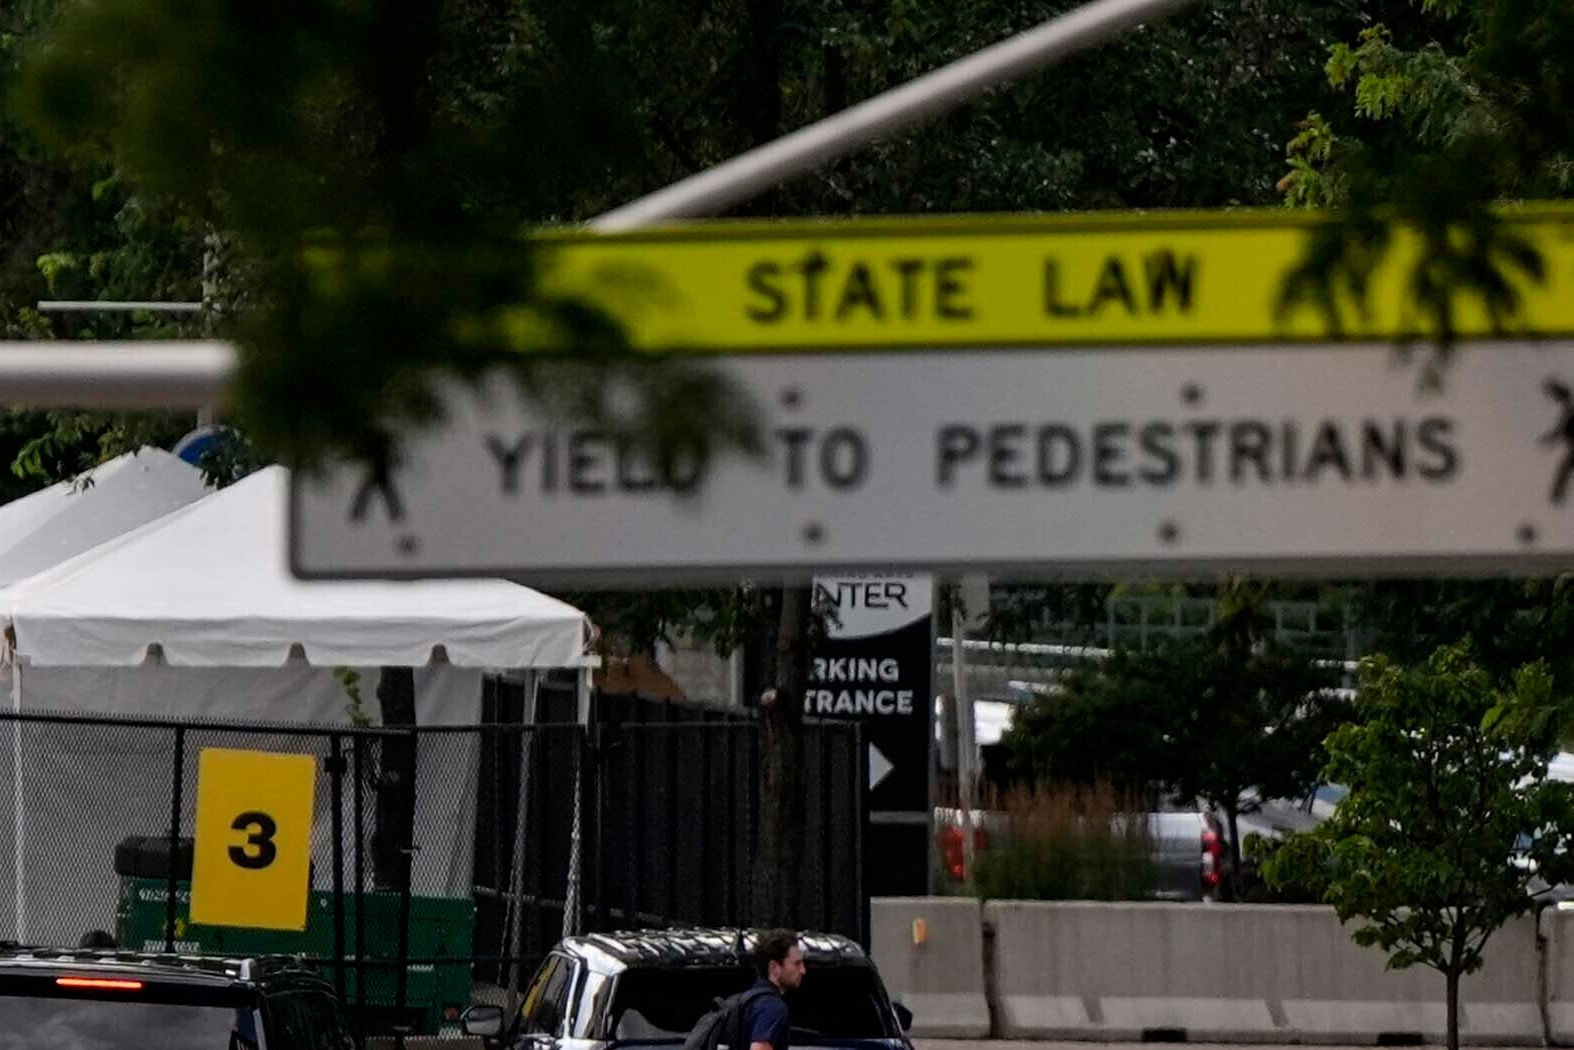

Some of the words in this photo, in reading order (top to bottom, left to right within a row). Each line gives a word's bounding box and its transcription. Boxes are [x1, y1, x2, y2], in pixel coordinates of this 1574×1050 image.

[744, 256, 976, 324] STATE
[1041, 250, 1198, 319] LAW
[485, 428, 711, 496] YIELD
[775, 425, 870, 492] TO
[935, 415, 1459, 489] PEDESTRIANS
[815, 582, 908, 609] NTER
[810, 658, 900, 682] RKING
[804, 689, 914, 714] TRANCE
[227, 811, 277, 870] 3
